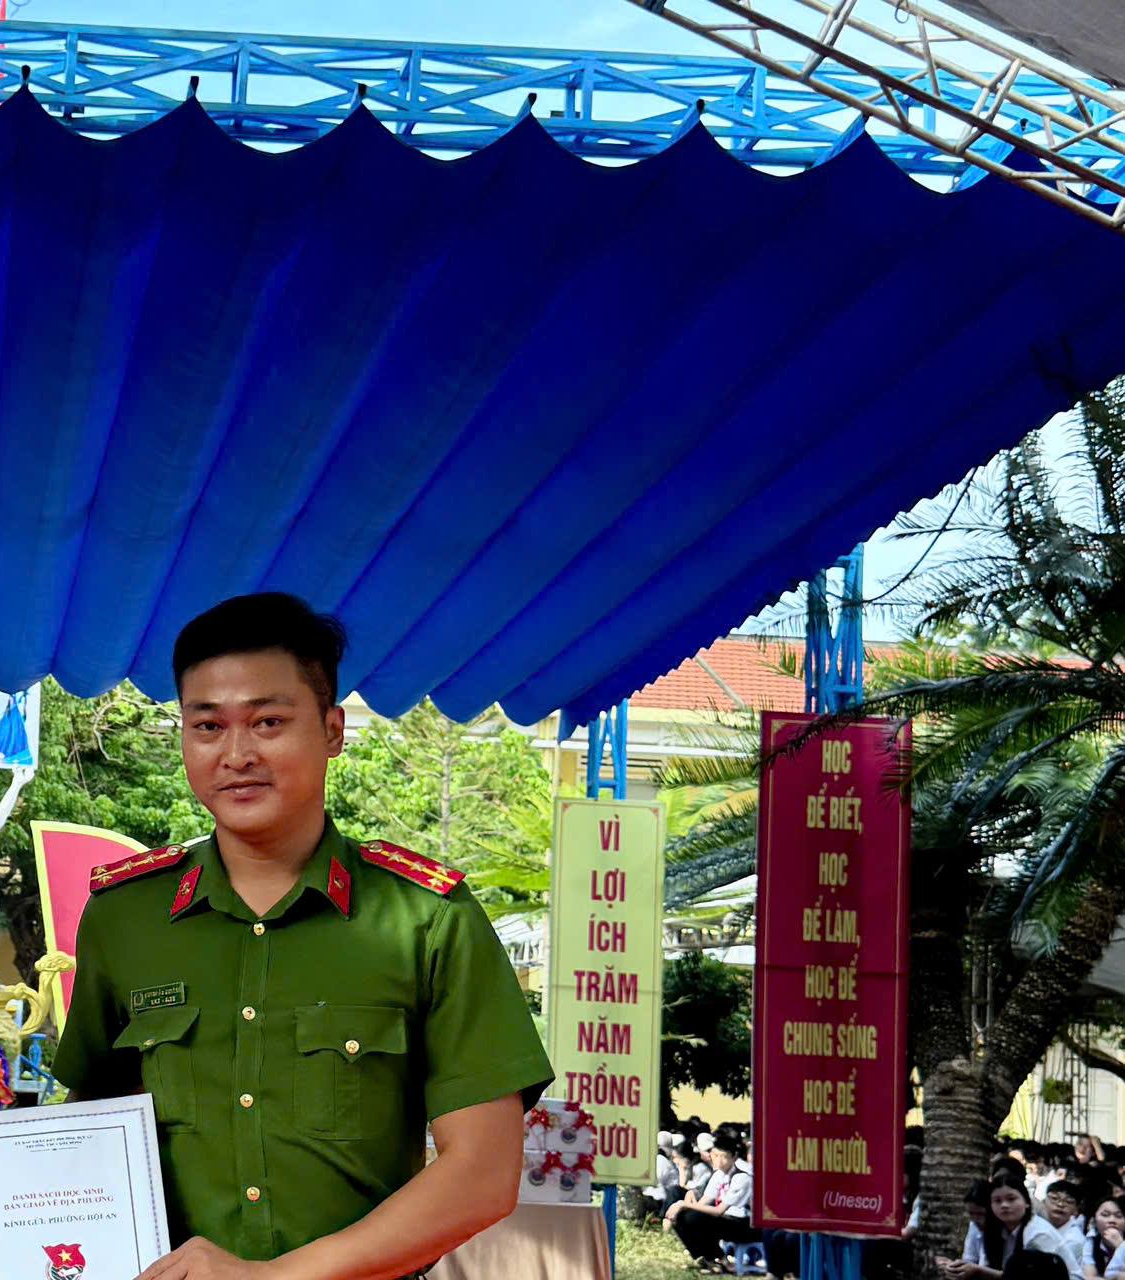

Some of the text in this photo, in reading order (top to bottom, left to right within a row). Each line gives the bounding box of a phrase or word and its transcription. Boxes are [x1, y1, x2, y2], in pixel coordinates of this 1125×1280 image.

[822, 739, 853, 782] HỌC
[806, 782, 863, 835] ĐỂ BIẾT,
[599, 813, 620, 852] VÌ
[591, 867, 626, 909] LỢI
[819, 852, 849, 893] HỌC
[588, 913, 626, 952] ÍCH
[803, 895, 860, 947] ĐỂ LÀM,
[574, 964, 639, 1004] TRĂM
[804, 953, 858, 1007] HỌC ĐỂ
[577, 1015, 631, 1056] NĂM
[783, 1012, 877, 1060] CHUNG SỐNG
[565, 1062, 641, 1107] TRỒNG
[803, 1067, 857, 1121] HỌC ĐỂ
[592, 1118, 638, 1159] ƯỜI
[787, 1129, 871, 1175] LÀM NGƯỜI.
[823, 1191, 882, 1213] (Unesco)
